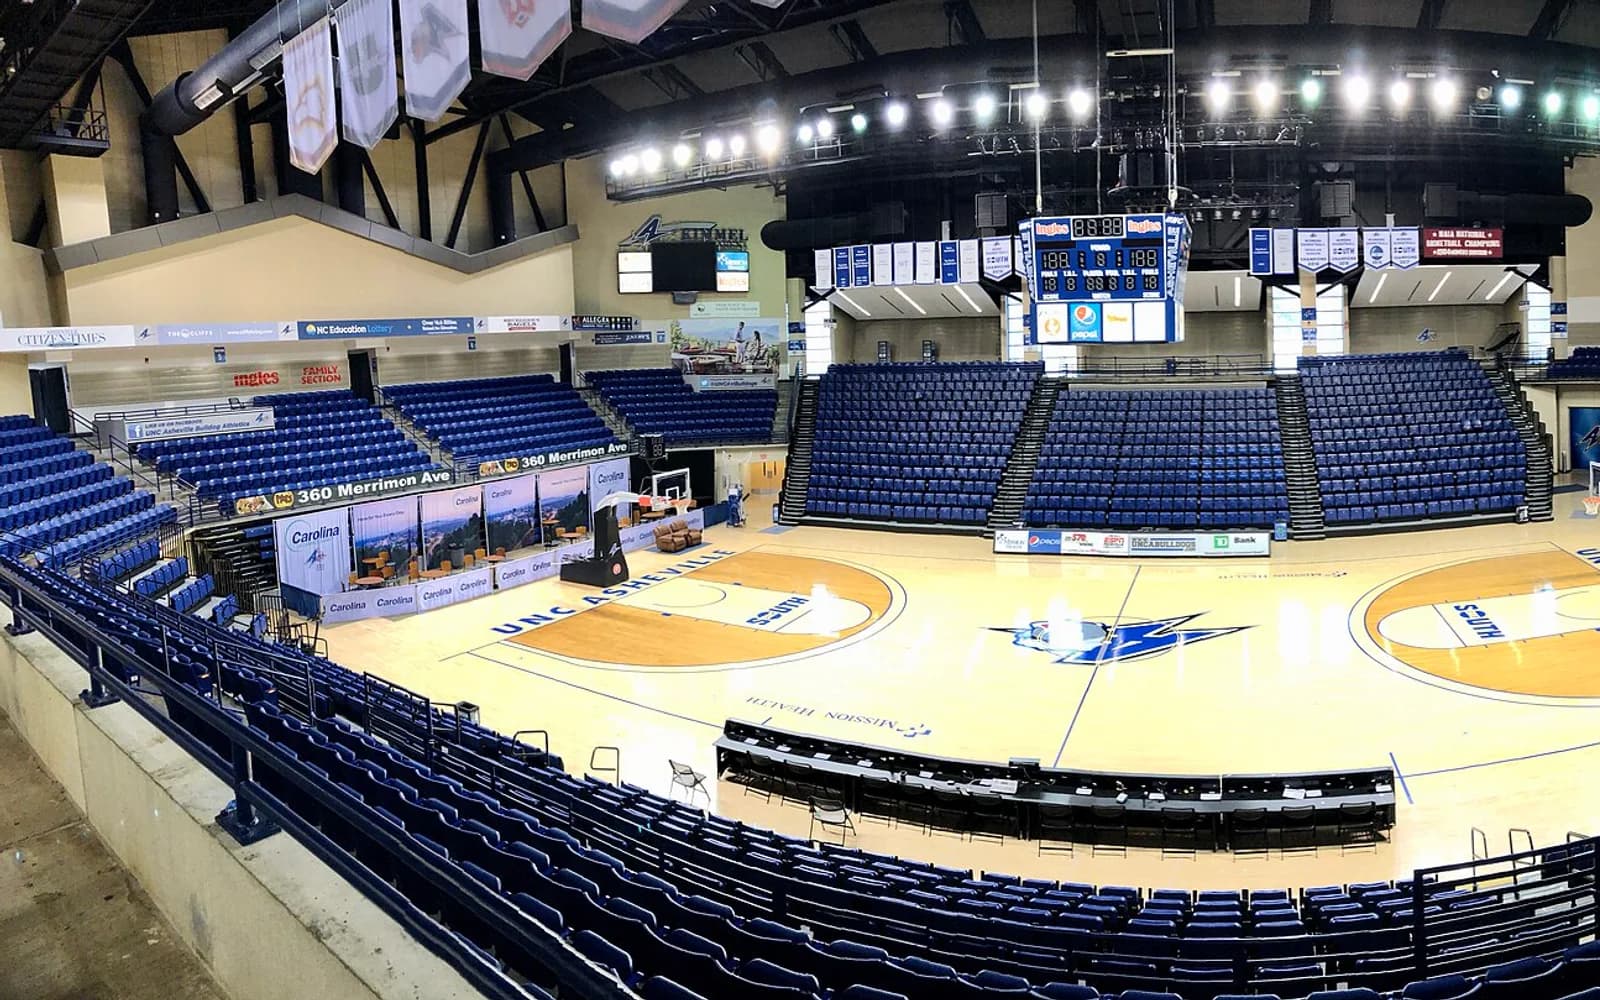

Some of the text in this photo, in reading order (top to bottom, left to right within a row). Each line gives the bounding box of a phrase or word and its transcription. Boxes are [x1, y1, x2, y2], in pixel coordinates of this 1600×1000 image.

[682, 228, 748, 241] KIMMEL
[1426, 239, 1501, 248] BASKETBALL CHAMPIONS
[986, 256, 1009, 264] SOUTH
[190, 330, 213, 338] CLIFFS
[316, 323, 394, 335] NC Education Lottery
[18, 332, 107, 346] CITIZEN-TIMES
[303, 365, 338, 376] FAMILY
[301, 374, 342, 385] SECTION
[145, 421, 250, 437] UNC Asheville Bulldog Athletics
[521, 456, 545, 469] 360
[548, 446, 606, 463] Merrimon
[607, 442, 628, 454] Ave
[598, 472, 624, 484] Carolina
[298, 487, 332, 504] 360
[337, 475, 417, 497] Merrimon
[421, 472, 450, 485] Ave
[491, 489, 513, 499] Carolina
[456, 494, 479, 506] Carolina
[292, 526, 340, 545] Carolina
[1233, 536, 1257, 544] Bank
[501, 567, 526, 581] Carolina
[459, 578, 488, 592] Carolina
[423, 587, 453, 601] Carolina
[489, 549, 737, 635] UNC ASHEVILLE
[329, 601, 367, 613] Carolina
[376, 596, 413, 608] Carolina
[745, 596, 810, 626] SOUTH
[1453, 604, 1506, 639] SOUTH
[746, 696, 899, 729] MISSION HEALTH
